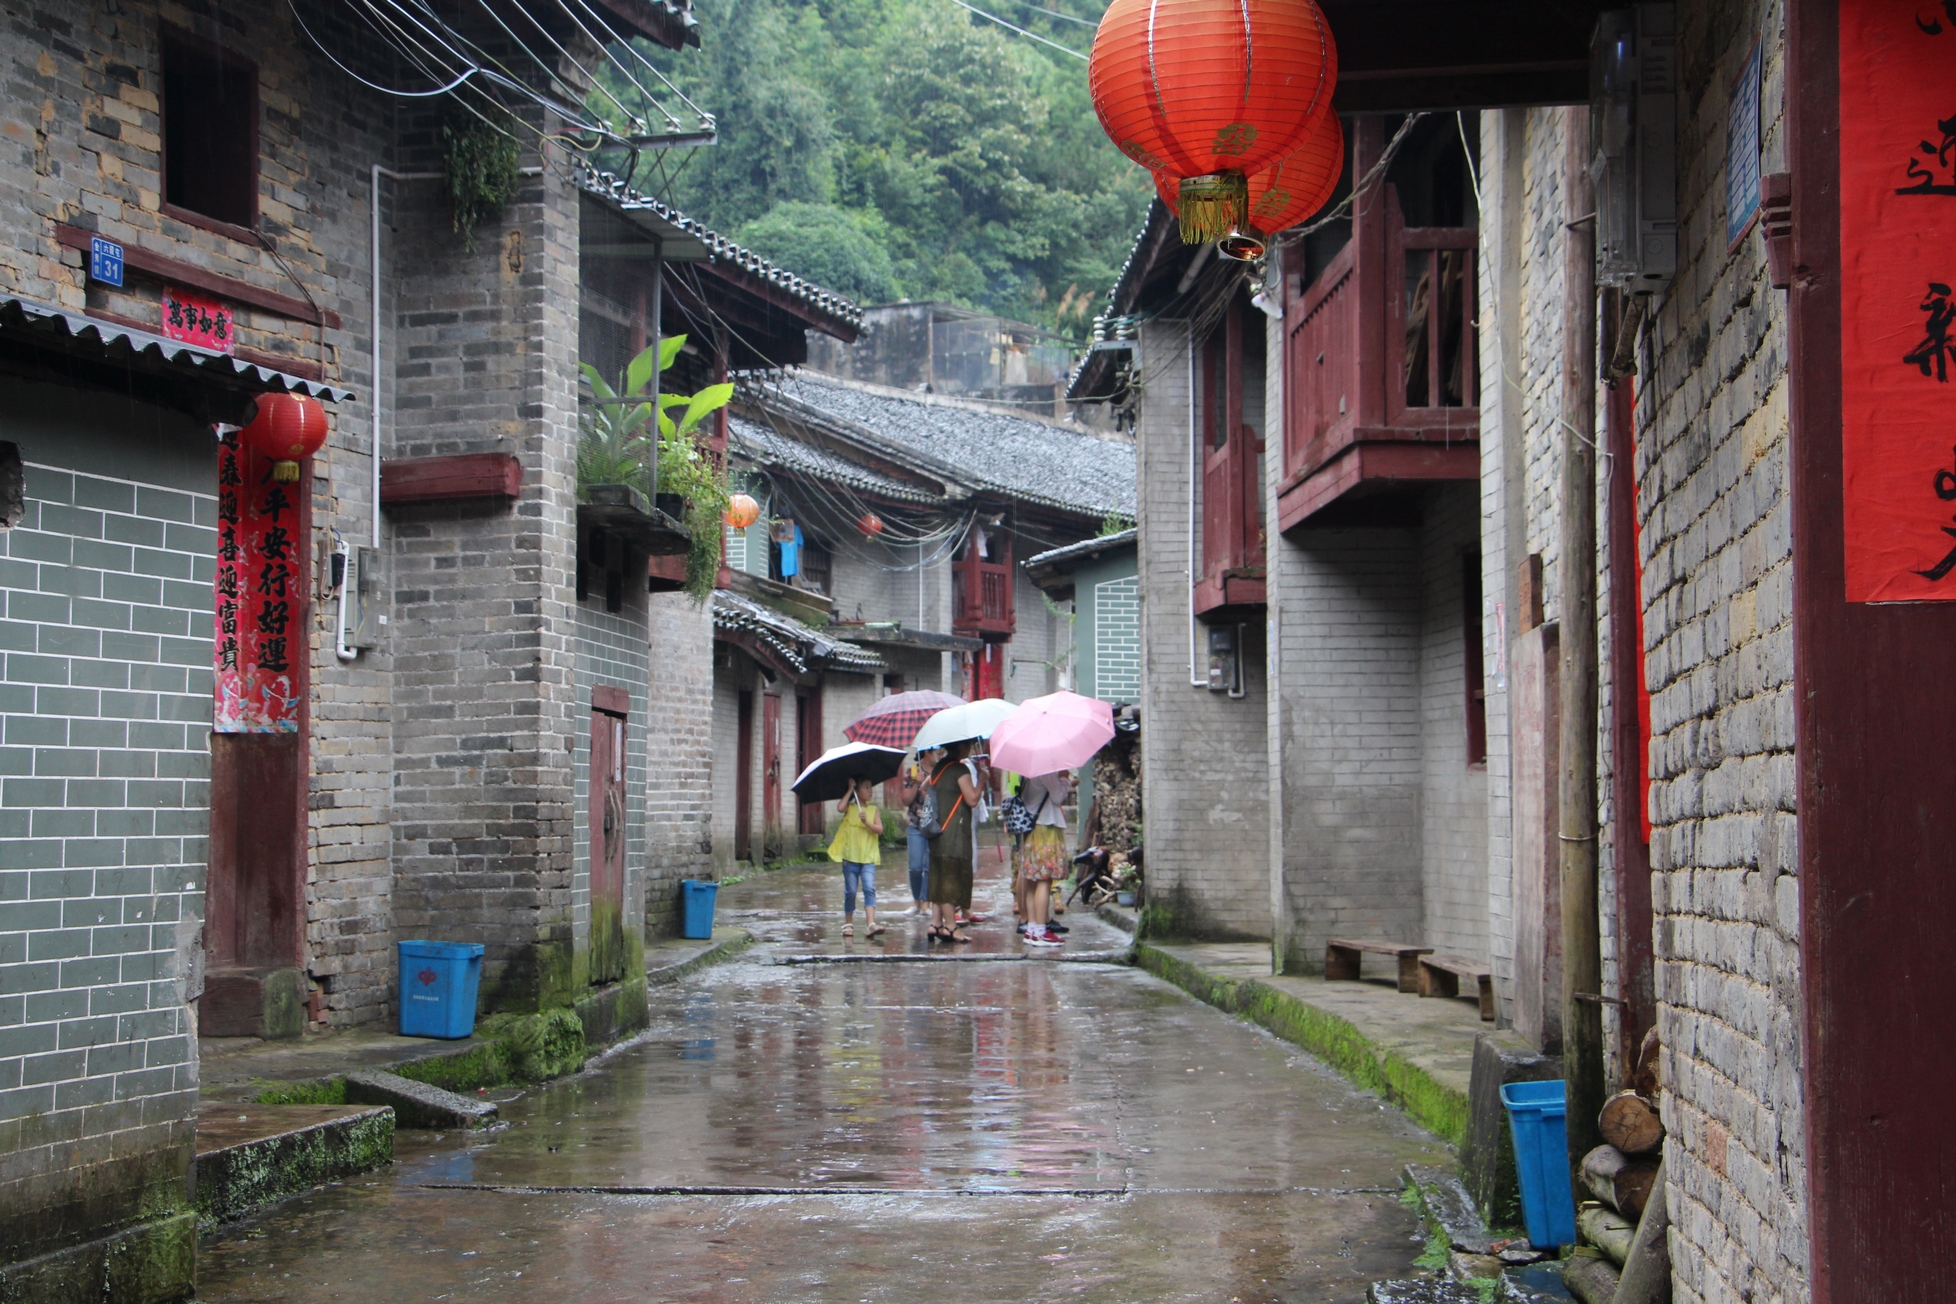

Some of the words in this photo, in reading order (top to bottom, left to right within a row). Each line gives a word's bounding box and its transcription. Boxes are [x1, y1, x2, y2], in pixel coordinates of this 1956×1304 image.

[104, 260, 119, 280] 31
[168, 300, 227, 340] 萬事如意
